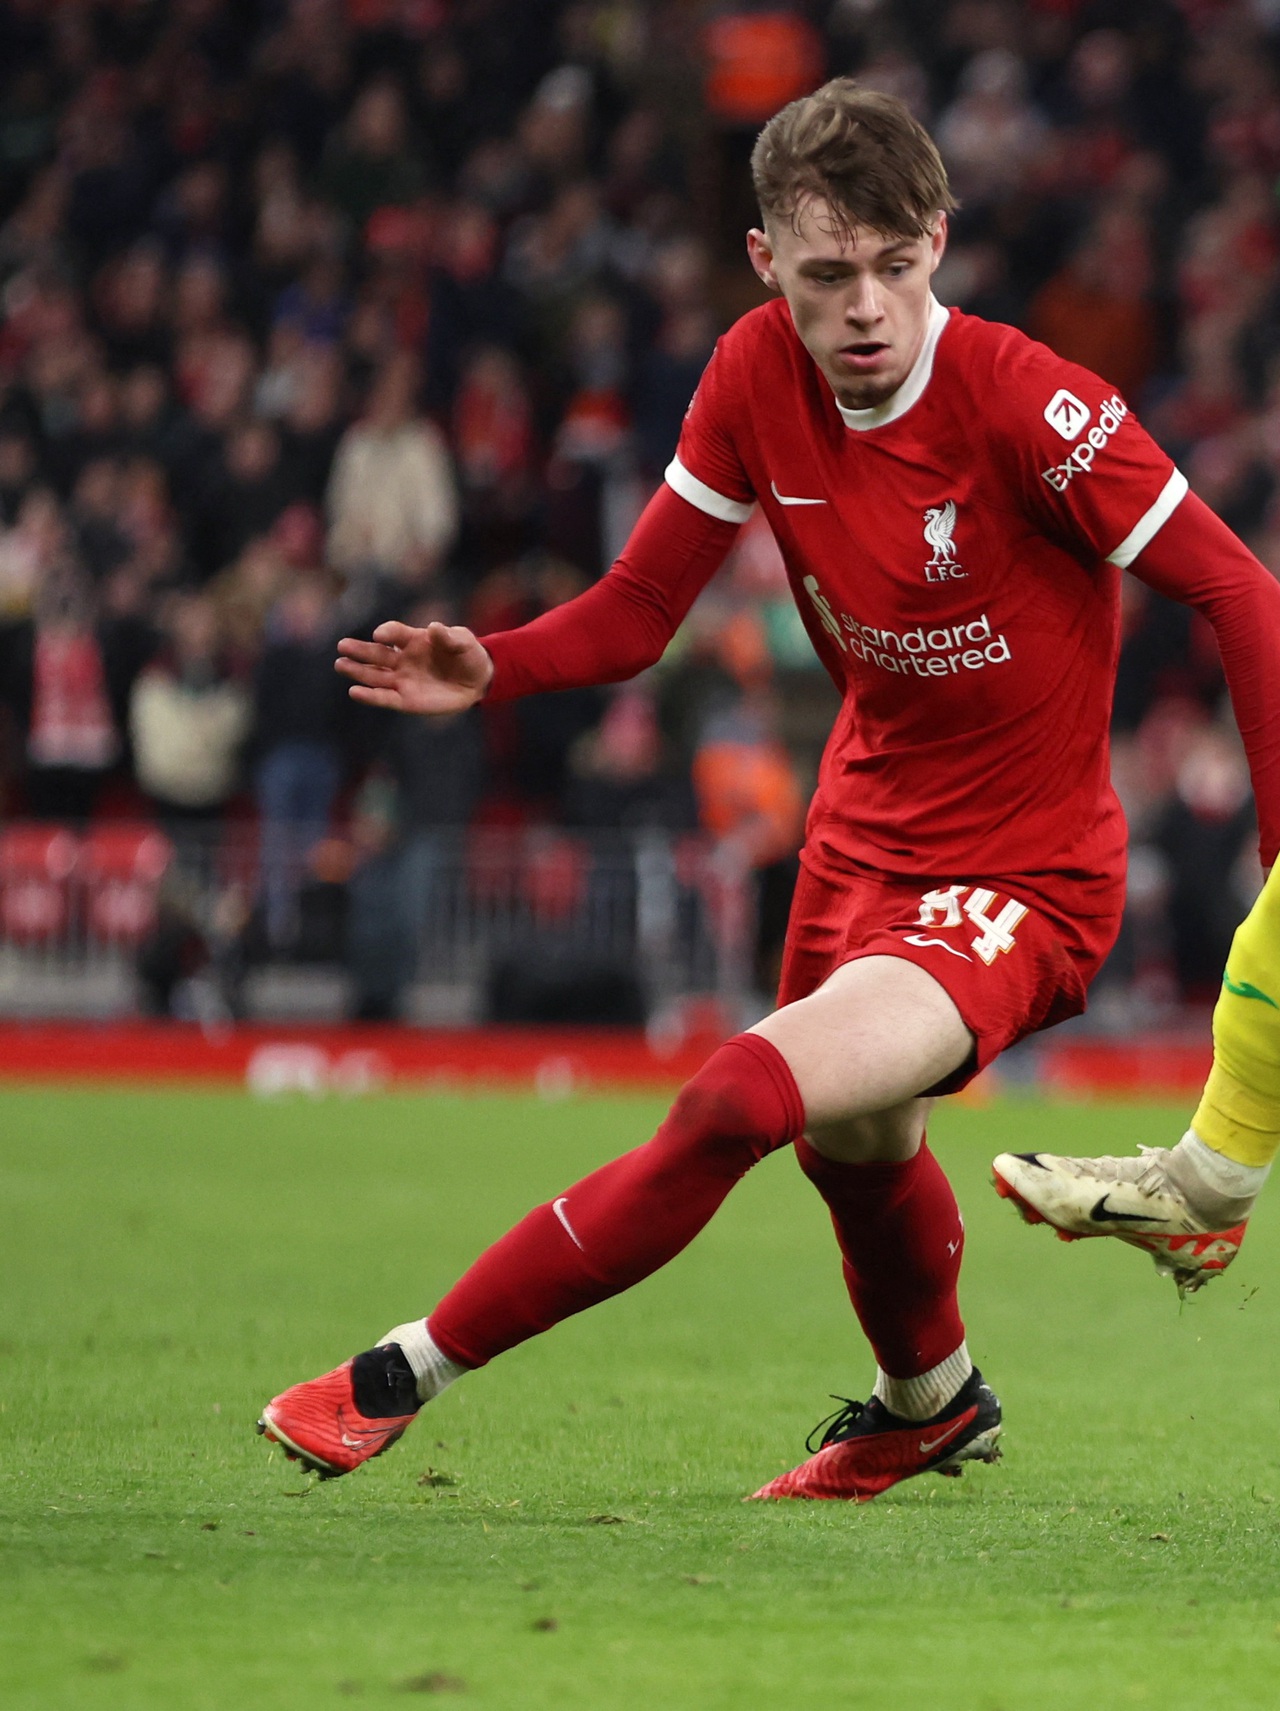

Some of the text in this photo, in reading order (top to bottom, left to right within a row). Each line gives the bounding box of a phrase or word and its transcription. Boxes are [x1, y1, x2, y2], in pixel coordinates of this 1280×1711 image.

[1041, 394, 1128, 492] Expedia
[850, 634, 1012, 677] chartered
[913, 884, 1030, 966] 84
